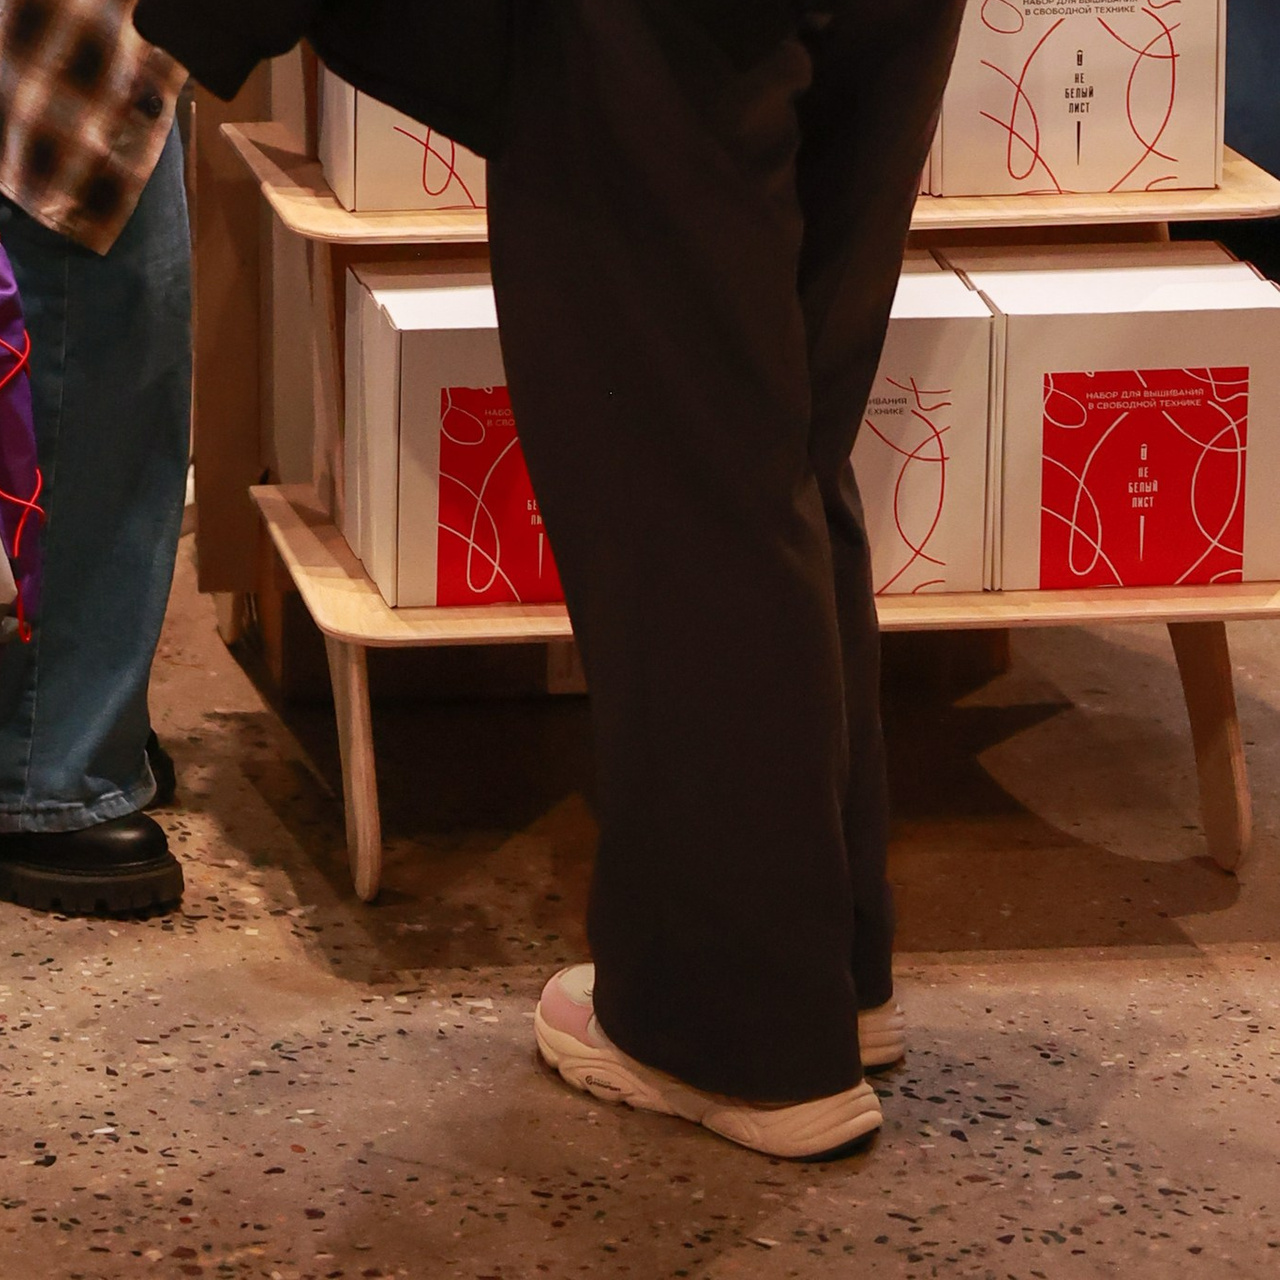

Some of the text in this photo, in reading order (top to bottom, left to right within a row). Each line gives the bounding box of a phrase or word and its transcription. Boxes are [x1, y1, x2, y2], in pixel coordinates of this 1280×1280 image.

[1033, 5, 1092, 16] СВОБОДНОЙ
[1095, 5, 1135, 14] ТЕХНИКЕ
[1074, 73, 1085, 83] НЕ
[1065, 86, 1094, 98] БЕЛЫЙ
[1068, 102, 1090, 113] ЛИСТ
[1086, 388, 1204, 400] НАБОР ДЛЯ ВЫШИВАНИЯ
[1088, 398, 1201, 410] В СВОБОДНОЙ ТЕХНИКЕ
[484, 408, 512, 416] НАБО
[1138, 466, 1149, 478] НЕ
[1128, 480, 1158, 494] БЕЛЫЙ
[1132, 496, 1154, 508] ЛИСТ
